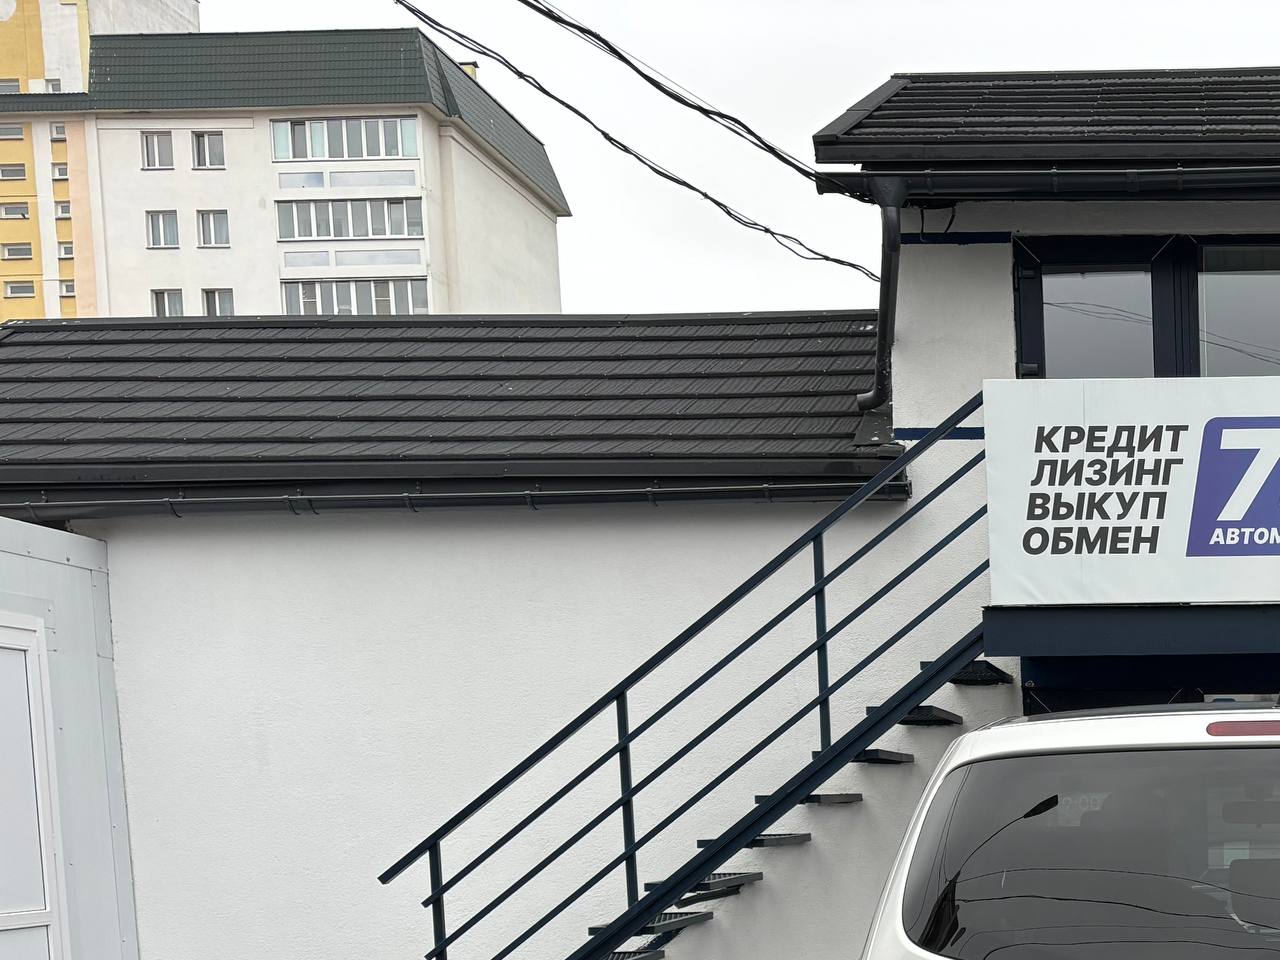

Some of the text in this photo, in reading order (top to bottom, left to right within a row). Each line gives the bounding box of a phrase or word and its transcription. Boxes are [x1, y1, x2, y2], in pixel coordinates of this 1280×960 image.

[1034, 425, 1189, 458] КРЕДИТ
[1030, 458, 1184, 487] ЛИЗИНГ
[1026, 491, 1168, 521] ВЫКУП
[1022, 525, 1160, 555] ОБМЕН
